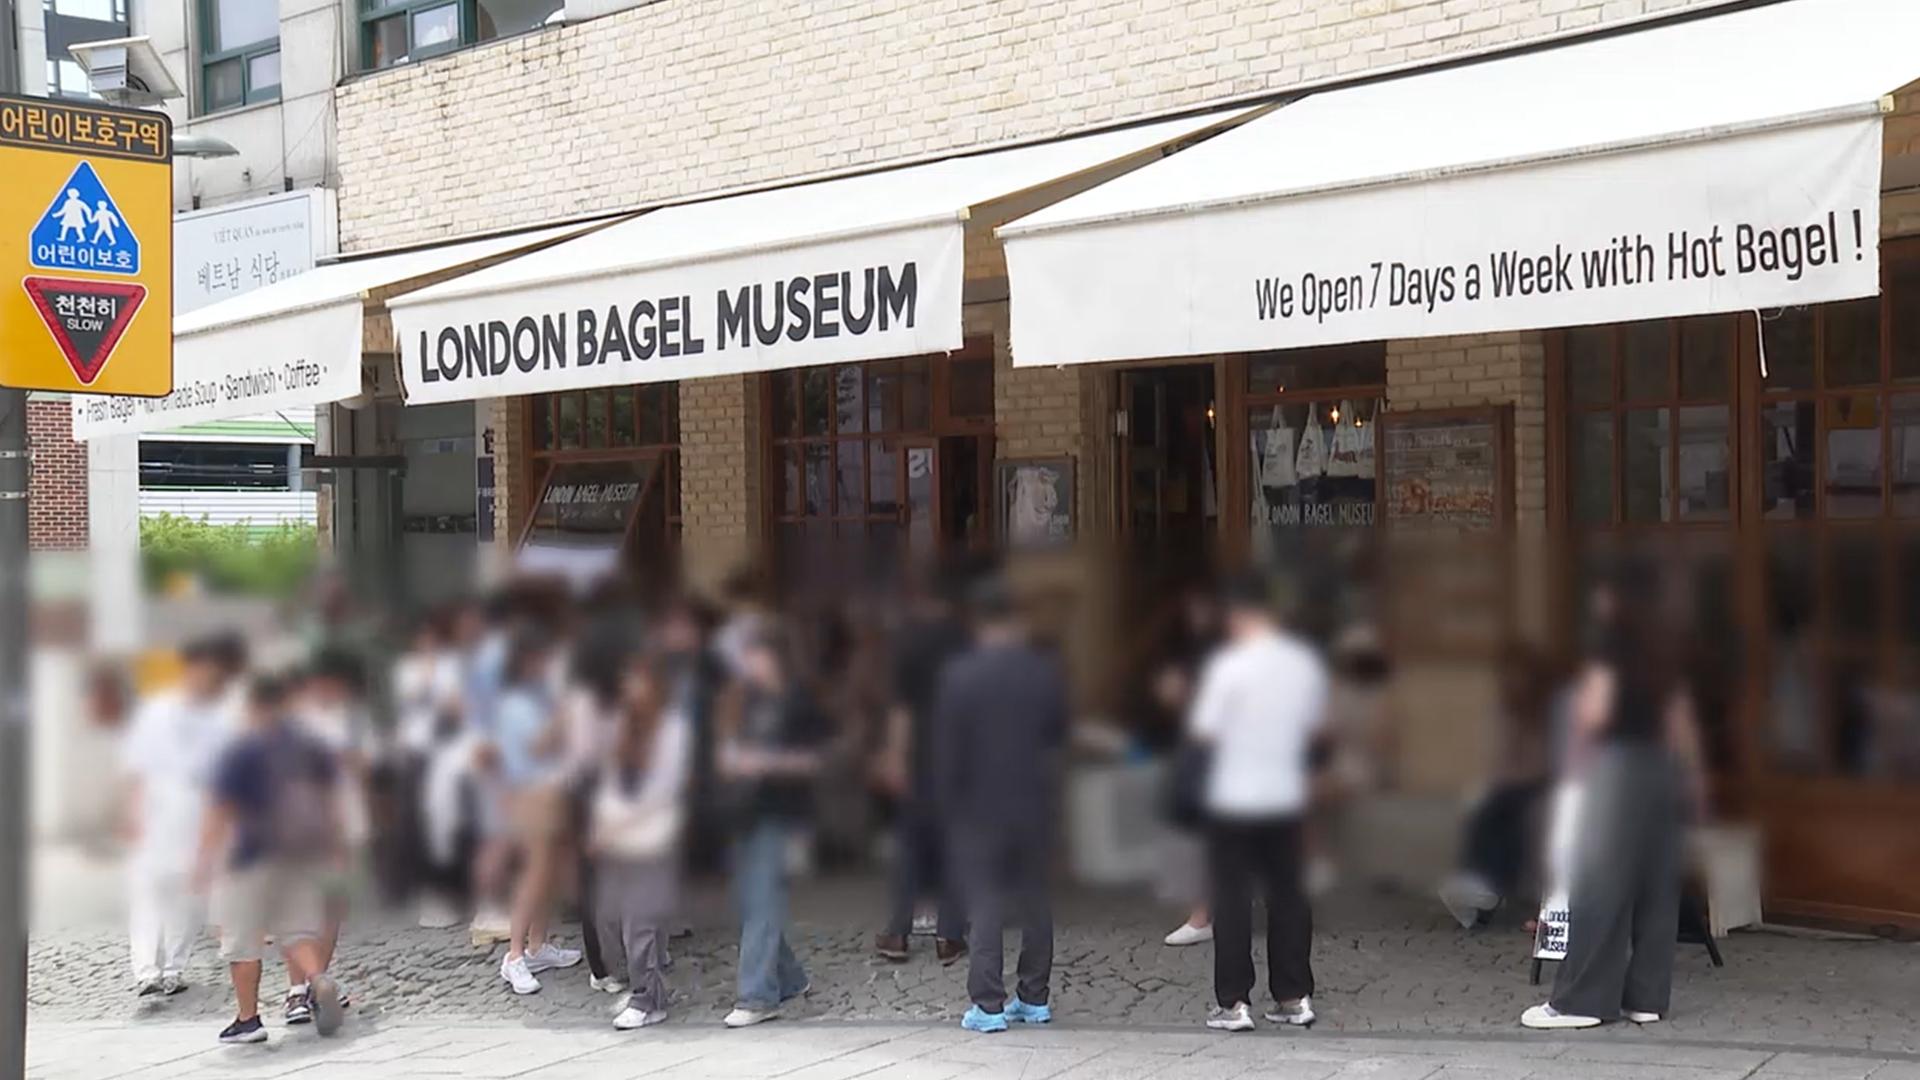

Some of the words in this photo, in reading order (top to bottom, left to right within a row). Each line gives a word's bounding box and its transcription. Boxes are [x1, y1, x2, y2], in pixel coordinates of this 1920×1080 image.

[1, 105, 160, 154] 어린이보호구역
[37, 244, 133, 270] 어린이보호
[196, 256, 242, 295] 베트남
[249, 249, 280, 286] 식당
[1256, 278, 1294, 321] We
[1302, 273, 1363, 324] Open
[1370, 263, 1383, 308] 7
[1390, 262, 1456, 314] Days
[1466, 263, 1481, 301] a
[1491, 244, 1573, 298] Week
[1582, 235, 1655, 290] with
[1669, 225, 1727, 281] Hot
[1737, 210, 1840, 281] Bagel
[55, 294, 117, 320] 천천히
[66, 317, 104, 332] SLOW
[420, 312, 567, 384] LONDON
[576, 295, 705, 367] BAGEL
[717, 261, 918, 351] MUSEUM
[194, 381, 218, 408] Soup
[225, 368, 276, 400] Sandwich
[283, 360, 320, 391] Coffee
[1304, 504, 1334, 525] BAGEL
